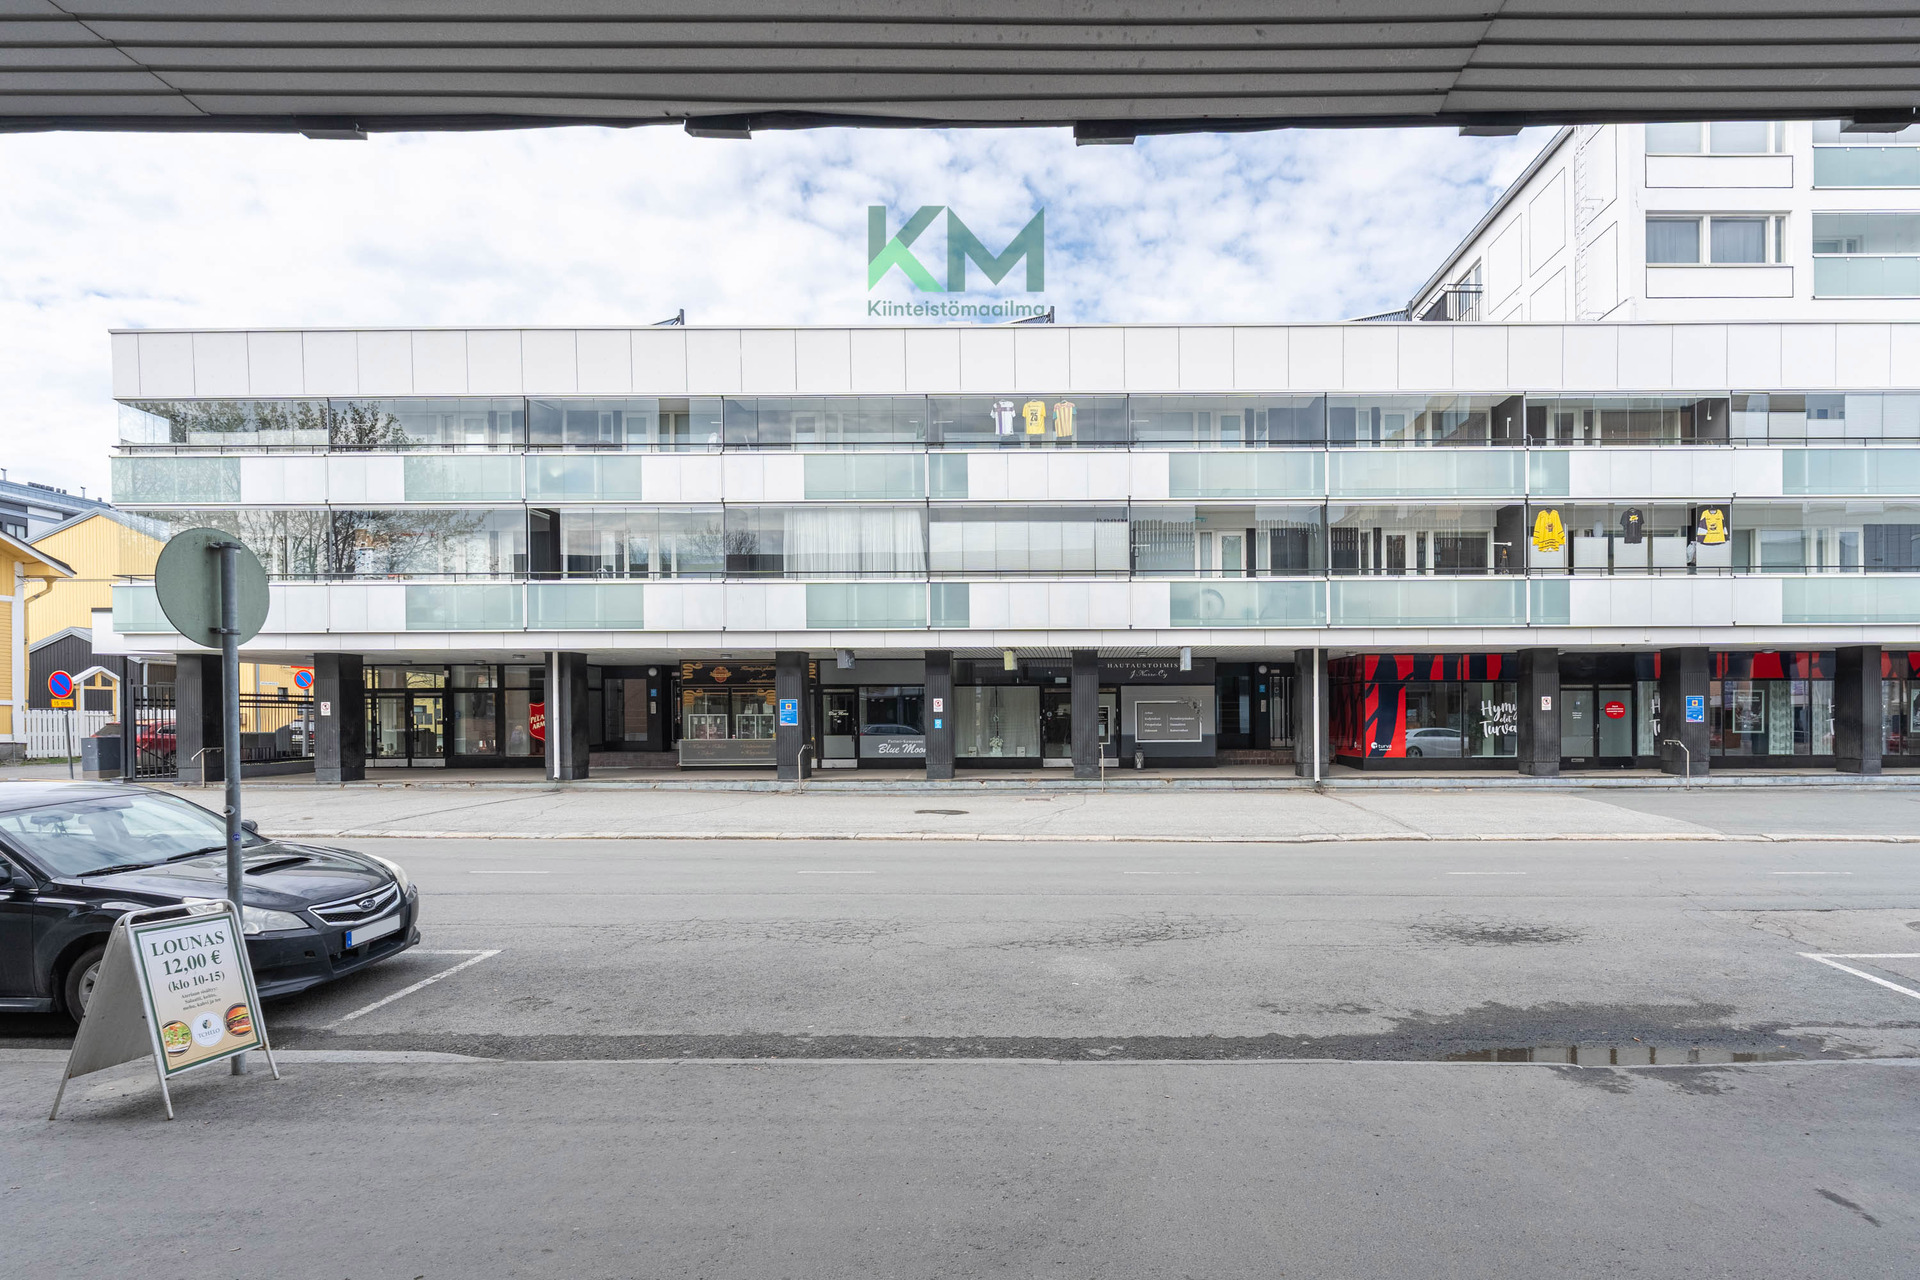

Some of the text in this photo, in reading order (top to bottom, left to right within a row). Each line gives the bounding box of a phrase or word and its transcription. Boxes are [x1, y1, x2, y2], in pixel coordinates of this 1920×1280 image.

[878, 743, 900, 754] Blue
[151, 931, 225, 956] LOUNAS
[163, 953, 206, 975] 12,00
[168, 971, 225, 993] (klo 10-15)
